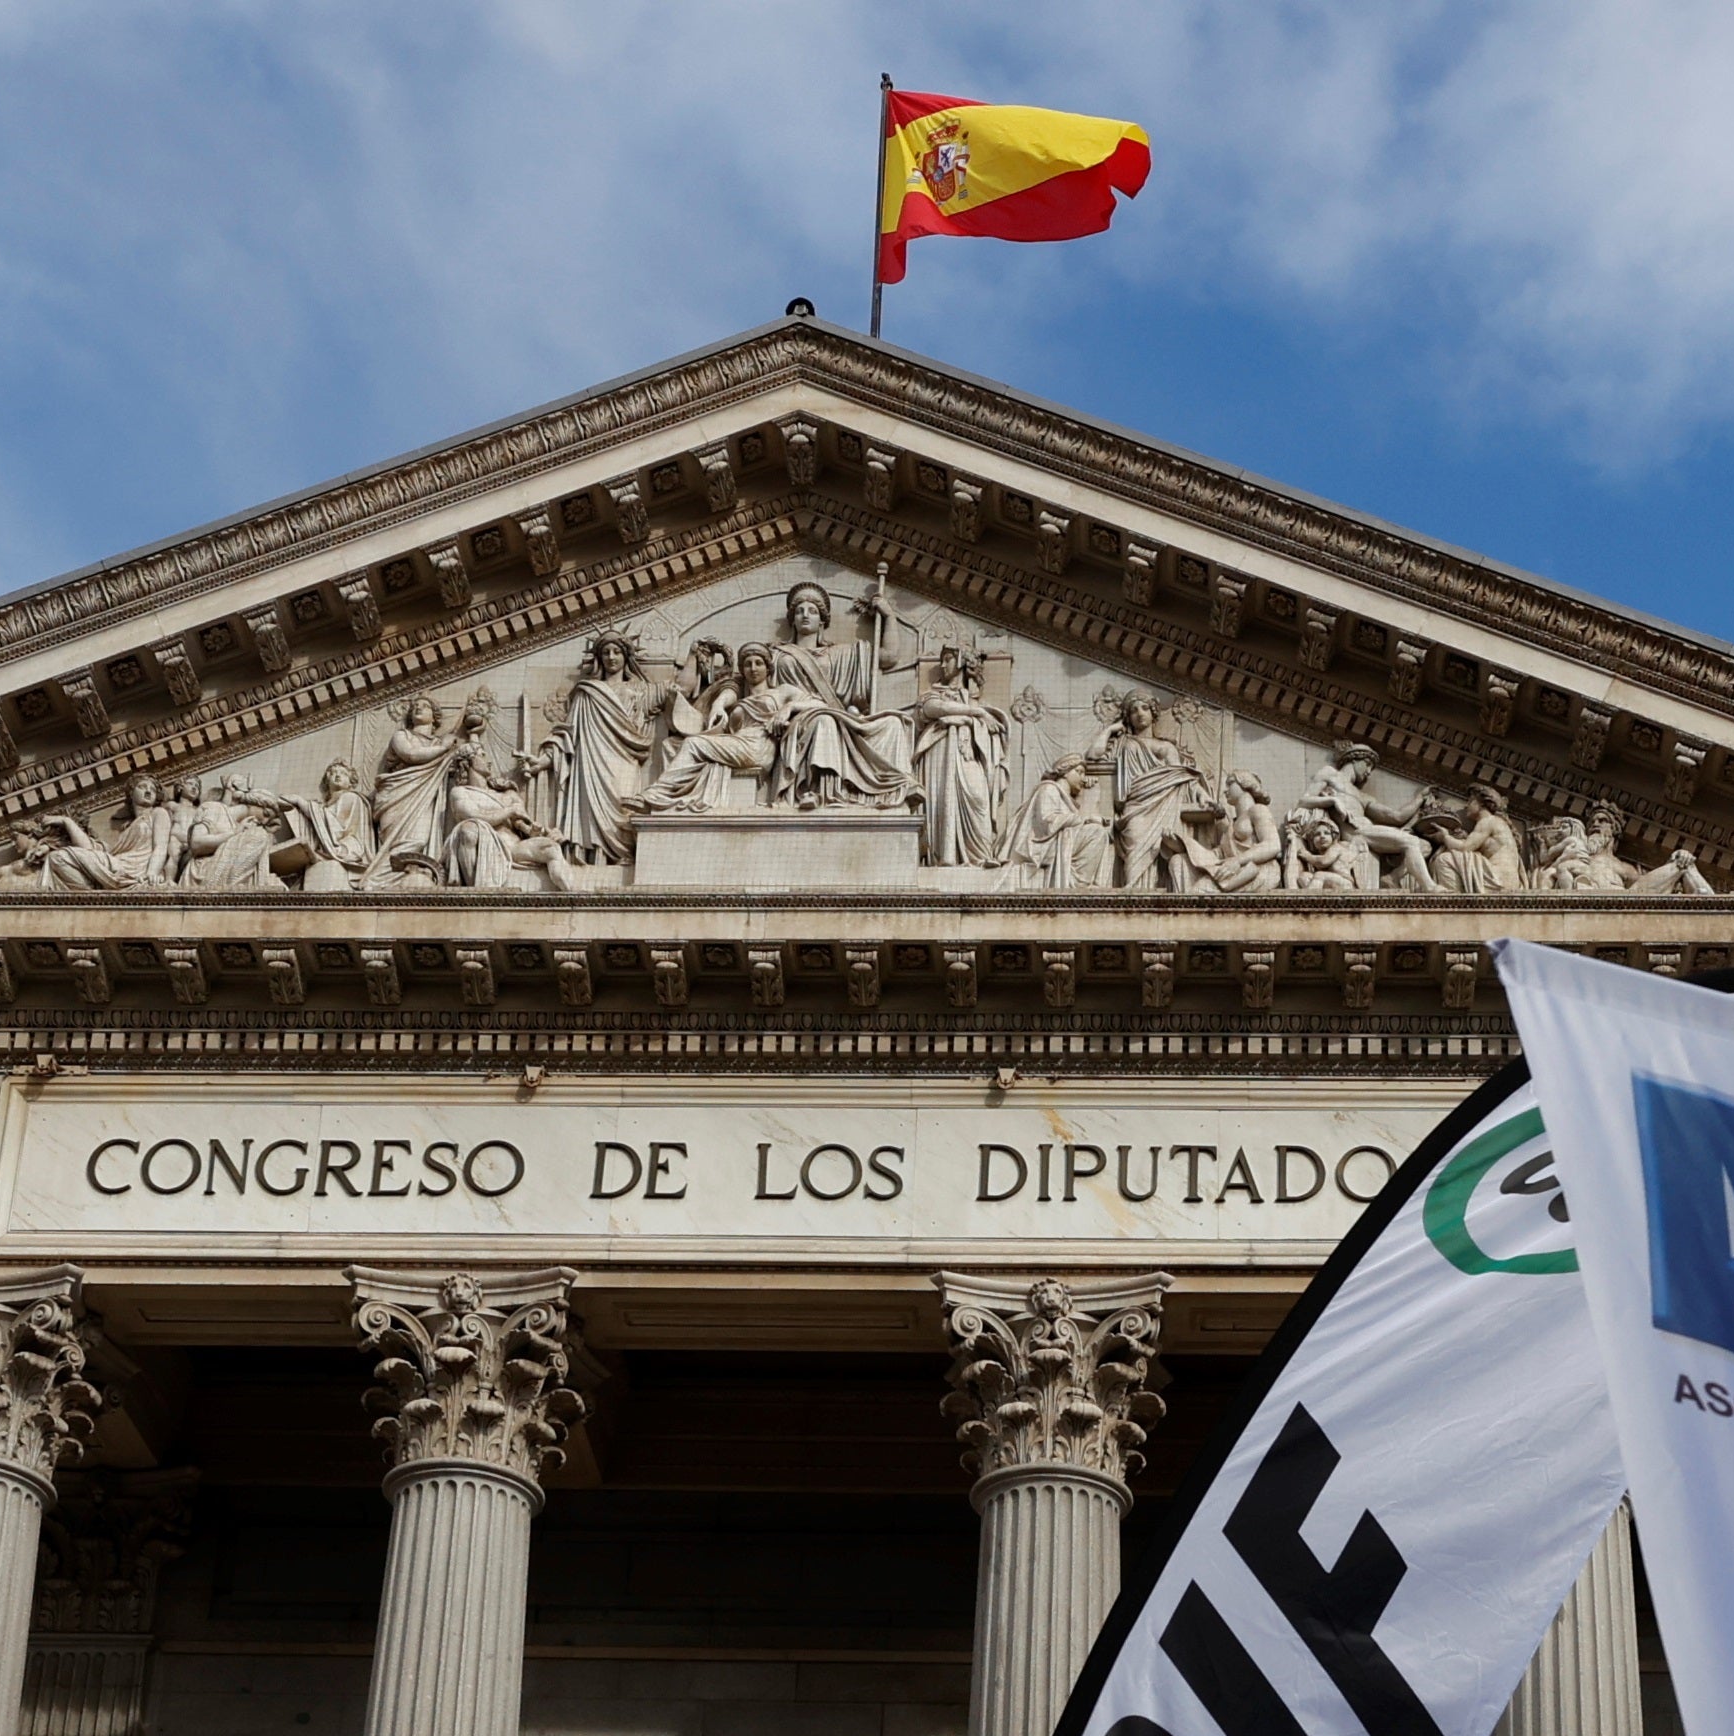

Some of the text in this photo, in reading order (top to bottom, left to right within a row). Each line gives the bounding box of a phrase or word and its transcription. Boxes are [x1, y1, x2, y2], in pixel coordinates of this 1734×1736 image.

[86, 1137, 1398, 1206] CONGRESO DE LOS DIPUTADO
